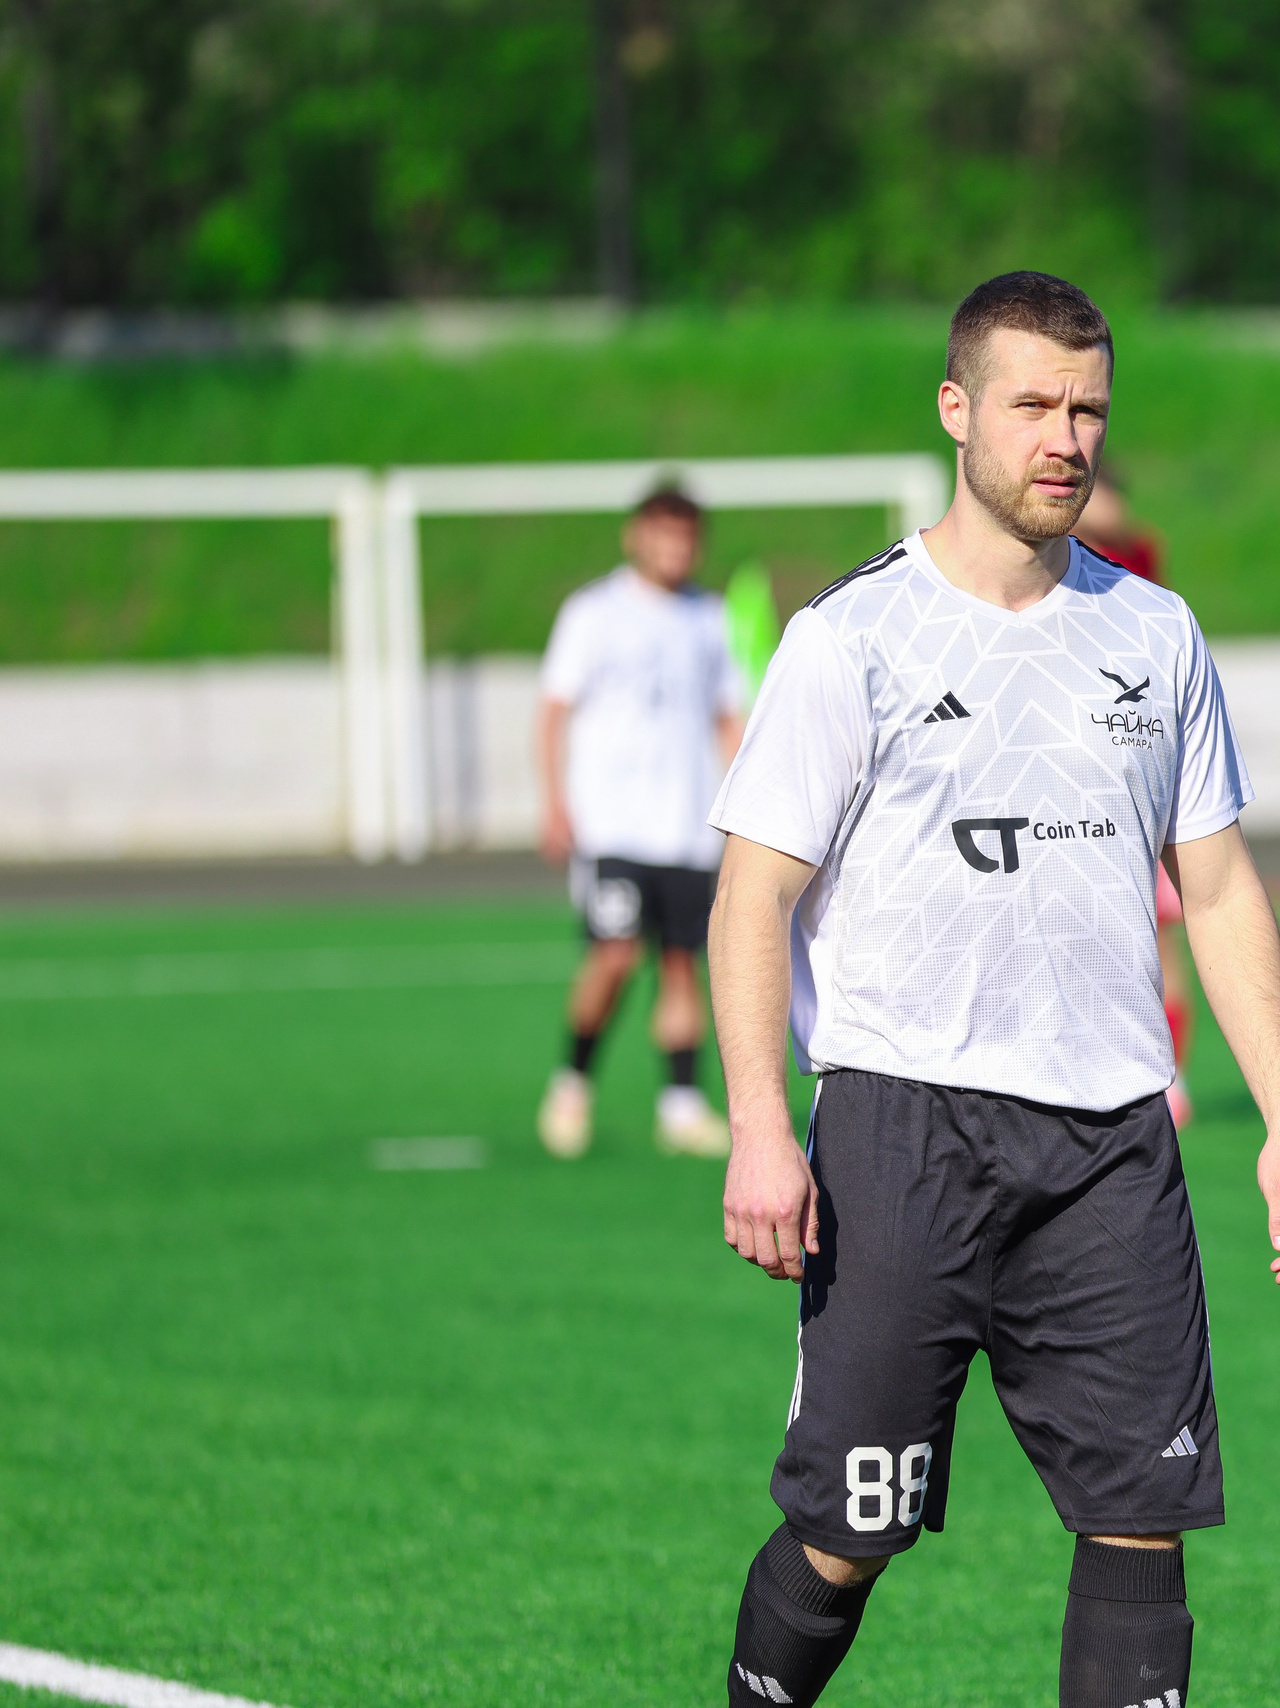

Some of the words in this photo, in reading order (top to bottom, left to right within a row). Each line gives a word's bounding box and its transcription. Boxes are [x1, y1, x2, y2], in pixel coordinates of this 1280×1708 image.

[1091, 710, 1164, 739] ЧАЙКА
[1112, 736, 1153, 751] САМАРА
[1033, 821, 1075, 841] Coin
[1078, 818, 1116, 839] Tab
[846, 1441, 933, 1532] 88
